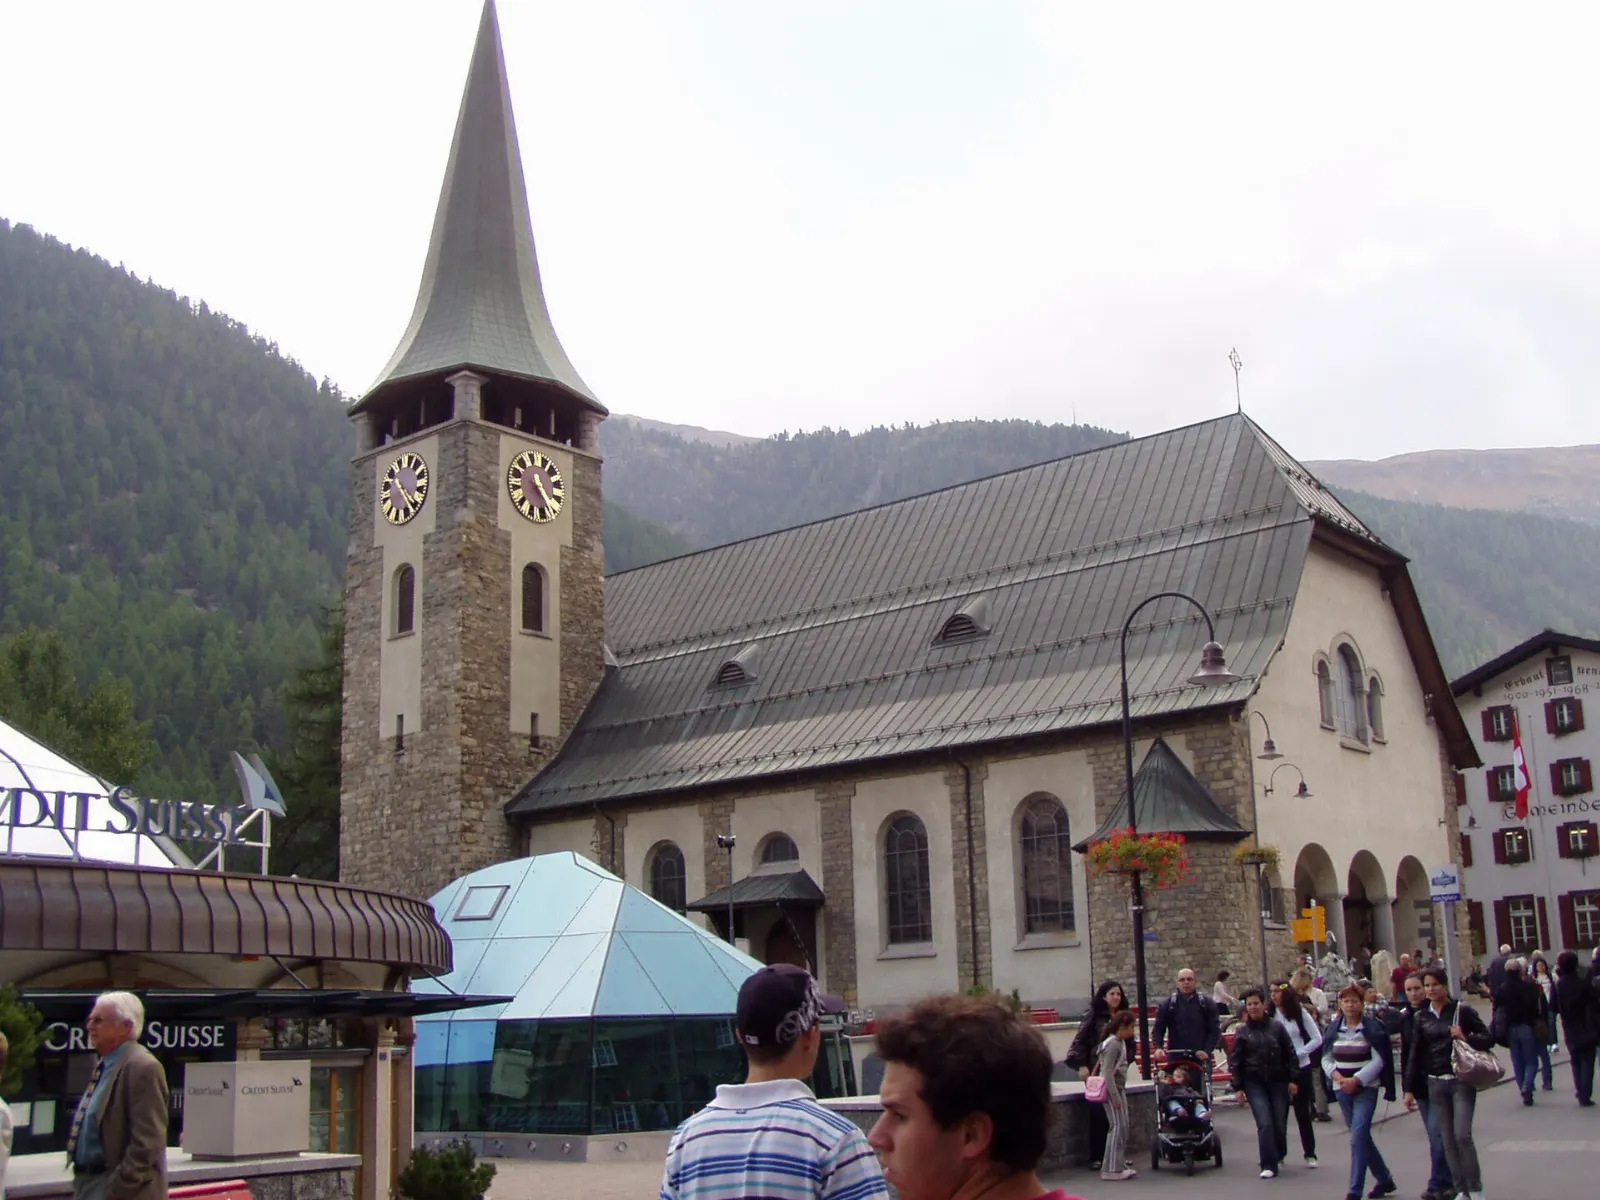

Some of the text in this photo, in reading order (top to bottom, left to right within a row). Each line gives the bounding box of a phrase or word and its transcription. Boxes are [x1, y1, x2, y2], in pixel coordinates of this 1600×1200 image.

[0, 785, 248, 843] DIT SUISSE
[1504, 798, 1600, 820] Gmeinde
[146, 1021, 225, 1048] SUISSE
